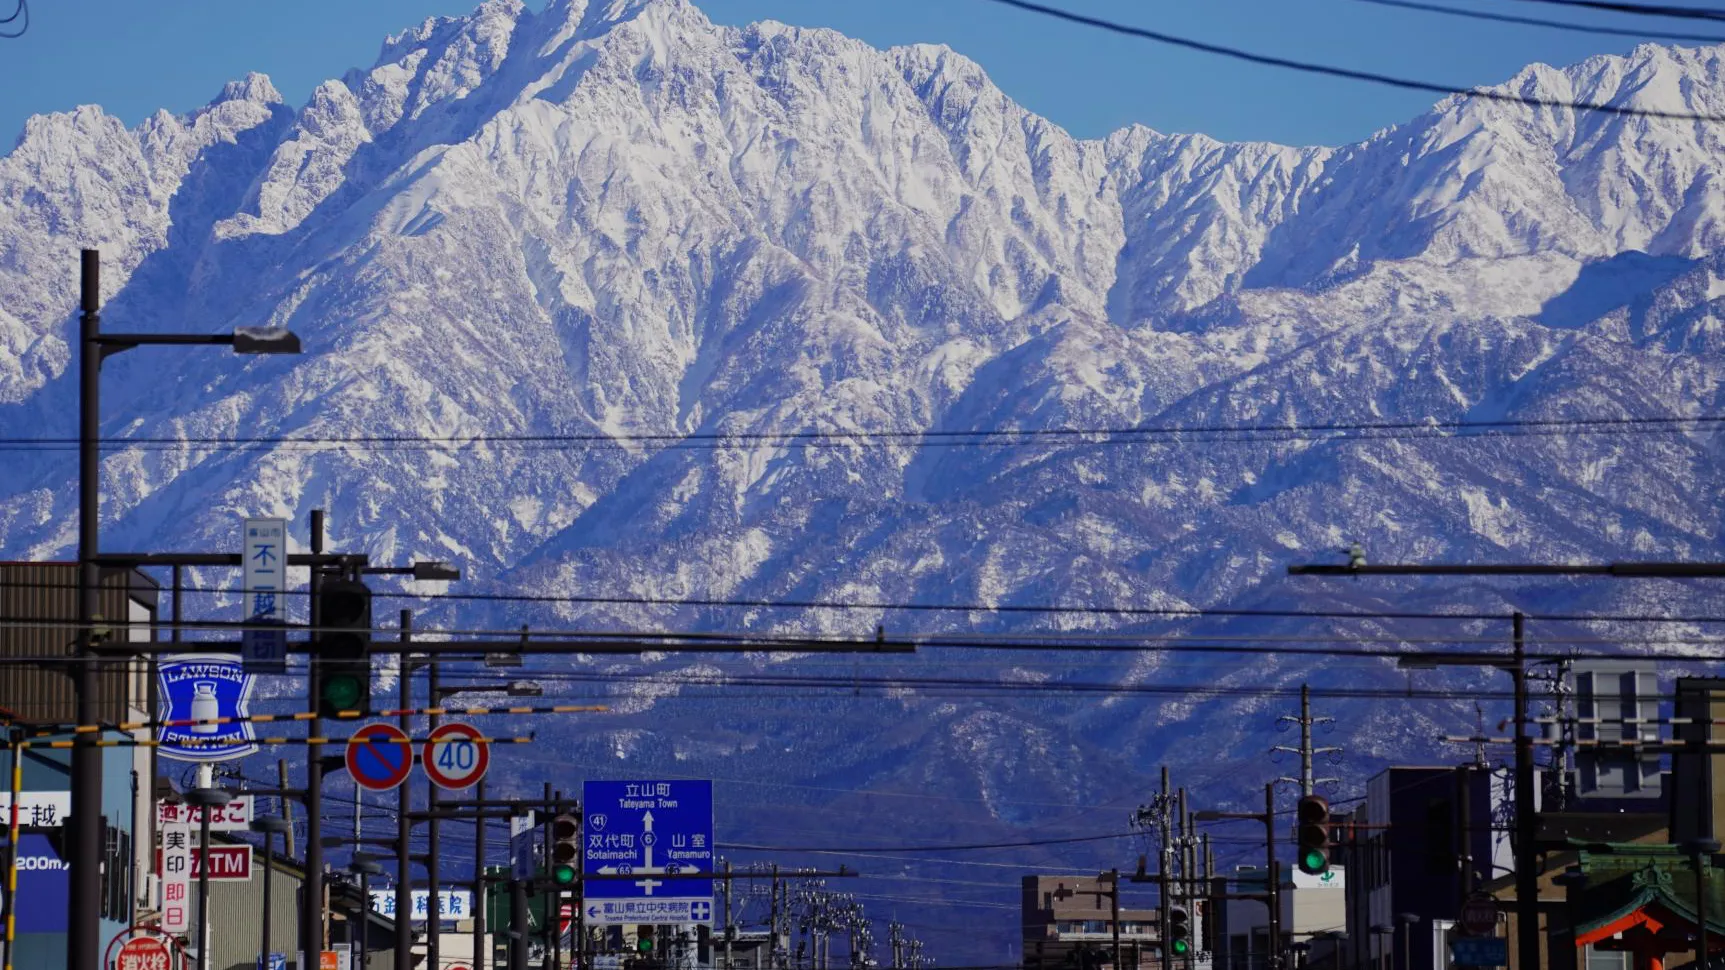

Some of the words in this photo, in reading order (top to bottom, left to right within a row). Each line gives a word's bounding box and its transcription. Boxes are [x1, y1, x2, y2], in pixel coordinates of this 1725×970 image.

[166, 664, 244, 684] LAWSON
[438, 740, 473, 770] 40
[625, 783, 671, 797] 立山町
[619, 799, 655, 811] Tateyama
[658, 799, 678, 808] Town
[0, 804, 56, 827] 二越
[593, 816, 604, 826] 41
[589, 834, 635, 848] 双代町
[672, 833, 705, 848] 山室
[587, 849, 637, 860] Sotaimachi
[667, 849, 710, 859] Yamamuro
[190, 853, 243, 873] ATM
[166, 831, 185, 926] 実印即日
[603, 902, 689, 914] 富山県立中央病院
[120, 952, 168, 970] 消火栓
